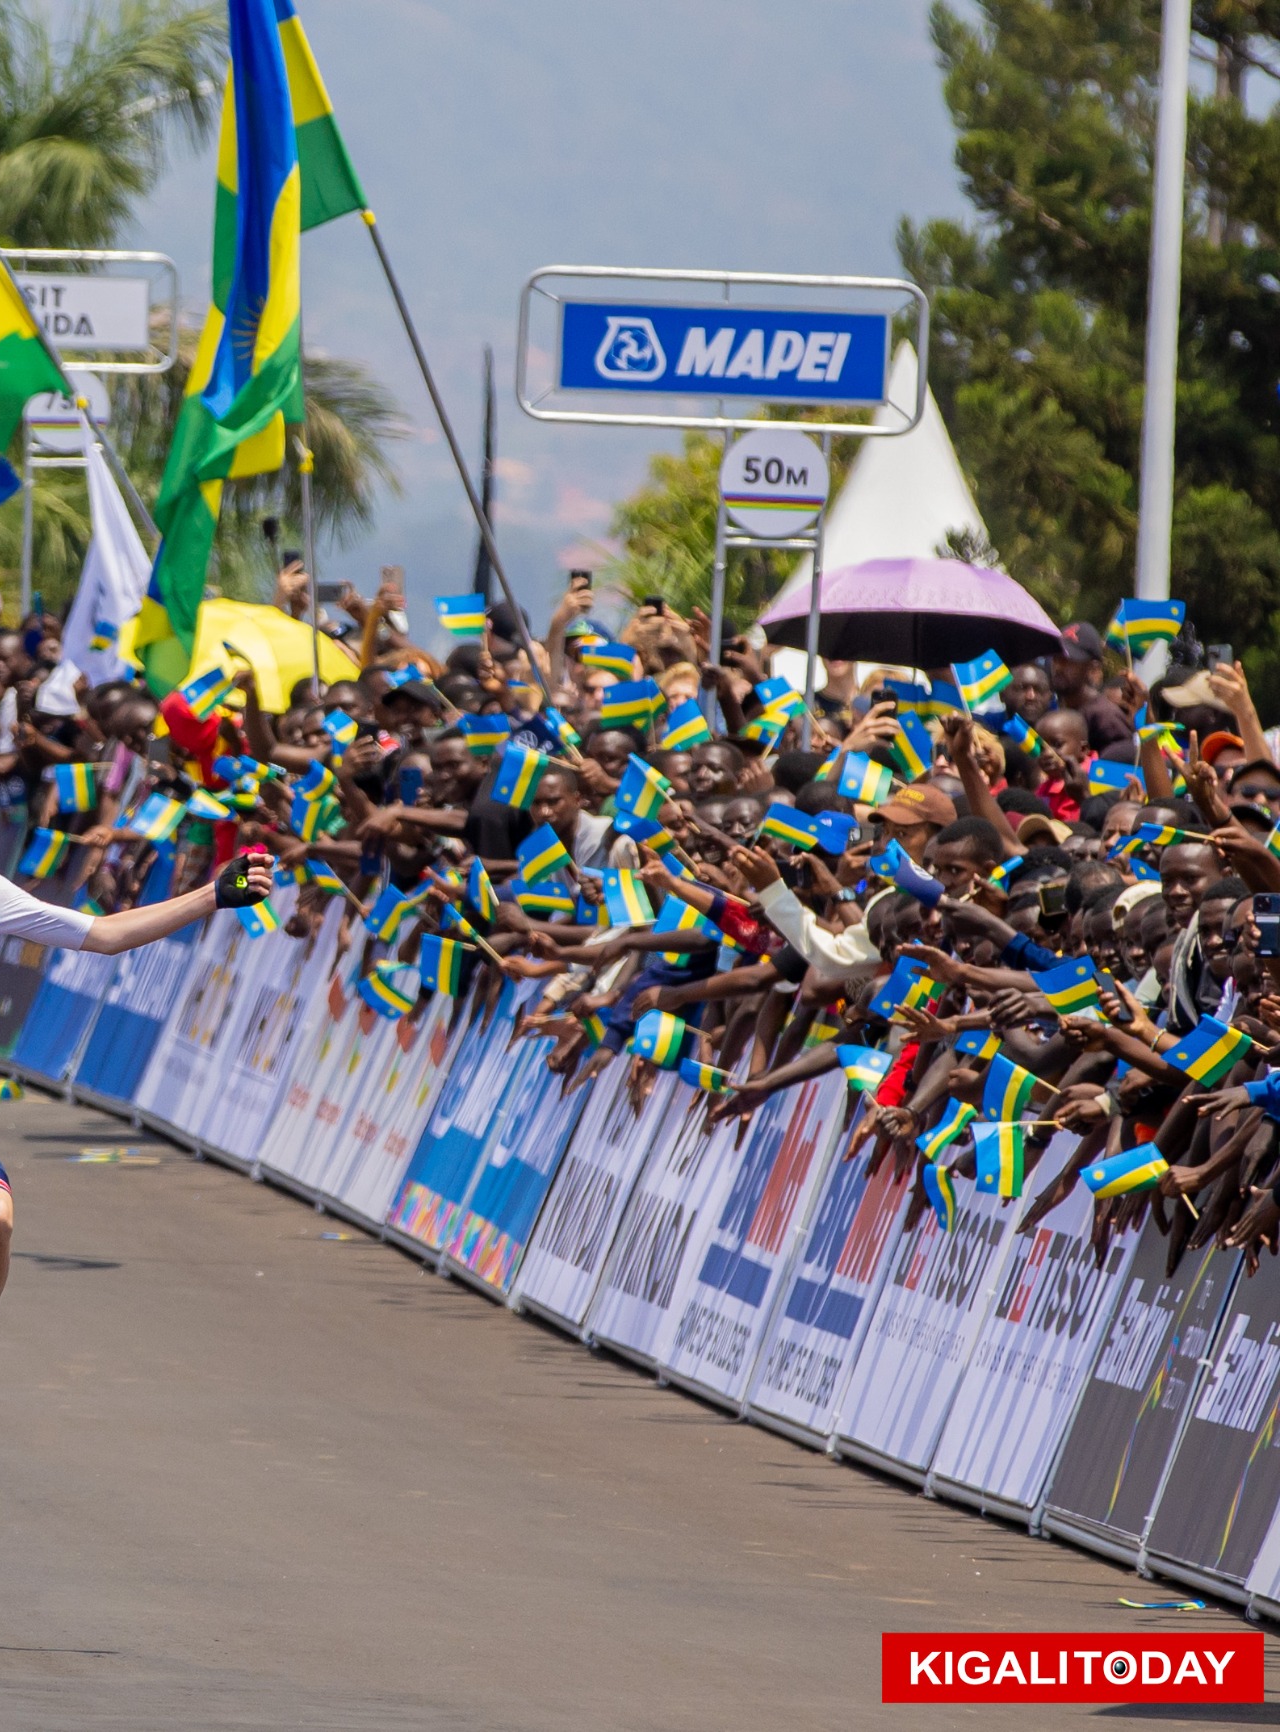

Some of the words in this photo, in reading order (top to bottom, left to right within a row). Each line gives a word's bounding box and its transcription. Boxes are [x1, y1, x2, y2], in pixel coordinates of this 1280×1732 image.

[23, 285, 66, 308] SIT
[675, 327, 852, 383] MAPEI
[743, 456, 808, 486] 50M
[1028, 1231, 1125, 1343] TISSOT
[1095, 1277, 1183, 1392] Santini
